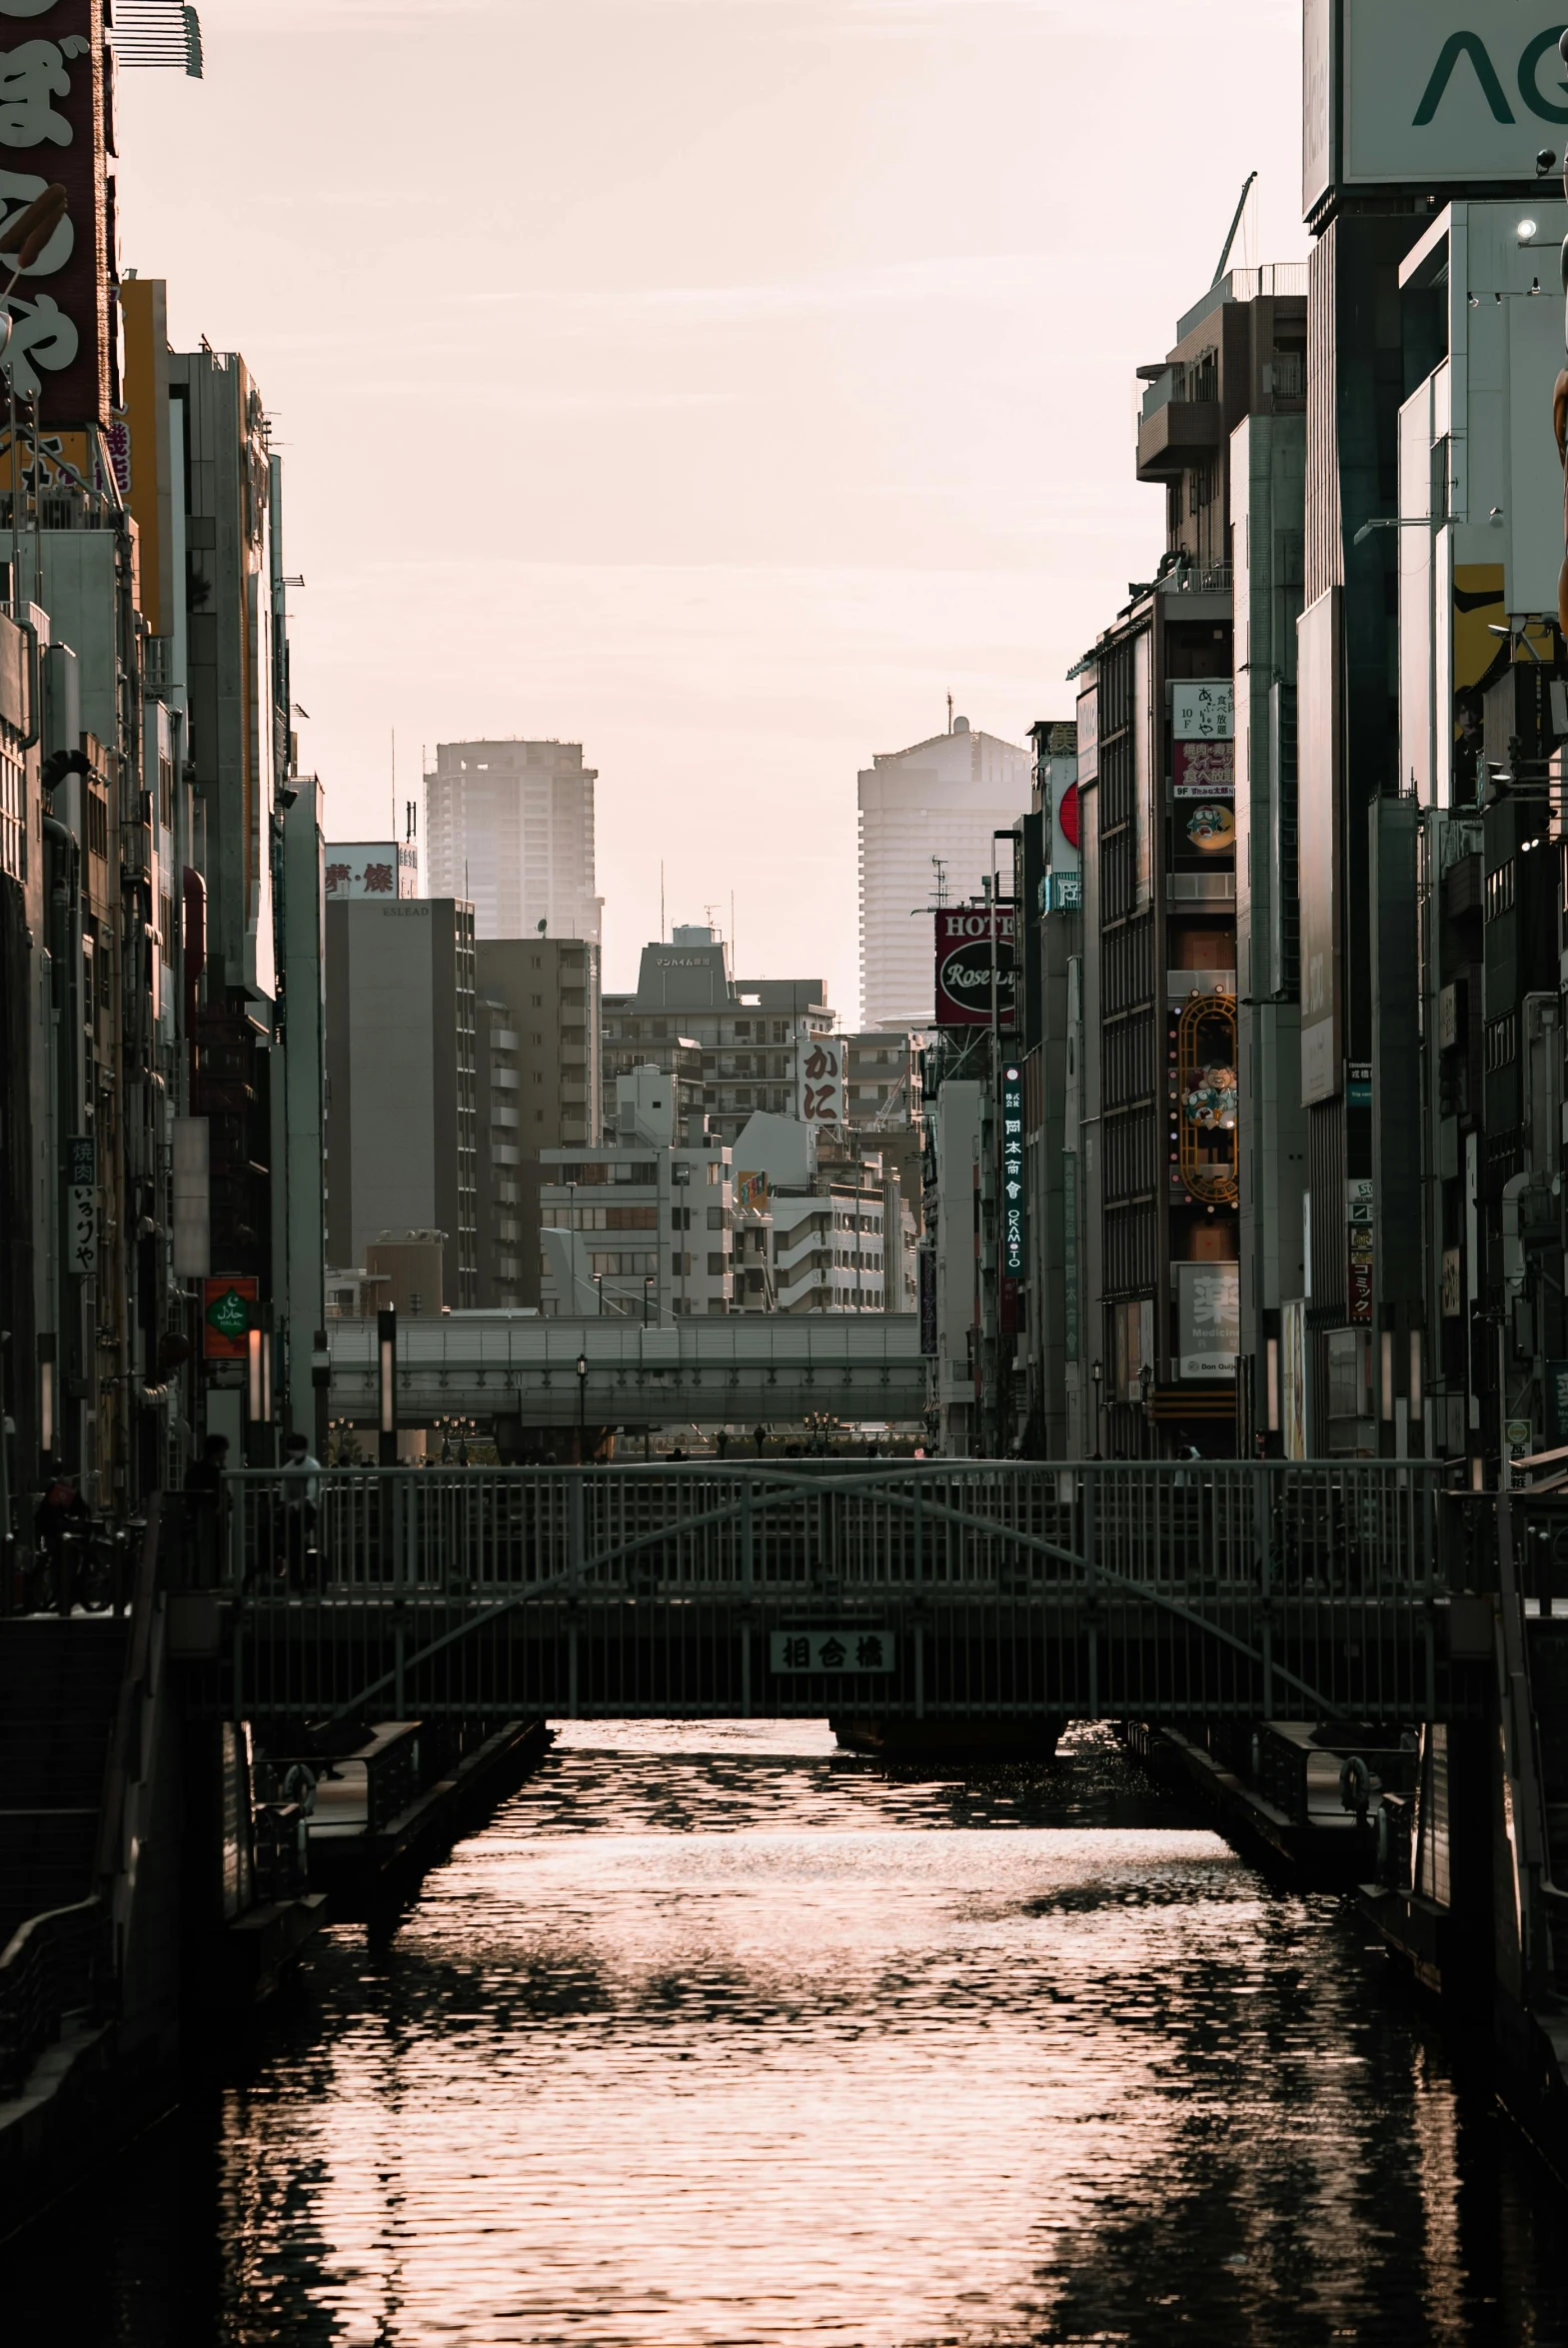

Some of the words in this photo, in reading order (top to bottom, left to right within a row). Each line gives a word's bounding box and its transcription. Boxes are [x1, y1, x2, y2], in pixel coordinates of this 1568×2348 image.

[1181, 708, 1193, 718] 10
[1183, 719, 1191, 729] F
[1216, 695, 1227, 735] 食べ放題
[384, 908, 430, 918] ESLEAD
[946, 963, 991, 988] Rose
[803, 1045, 837, 1119] かに
[73, 1142, 94, 1182] 焼肉
[1193, 1275, 1239, 1323] 薬
[1354, 1264, 1370, 1311] コミック
[1218, 1362, 1236, 1372] Quij
[784, 1635, 883, 1668] 相合橋
